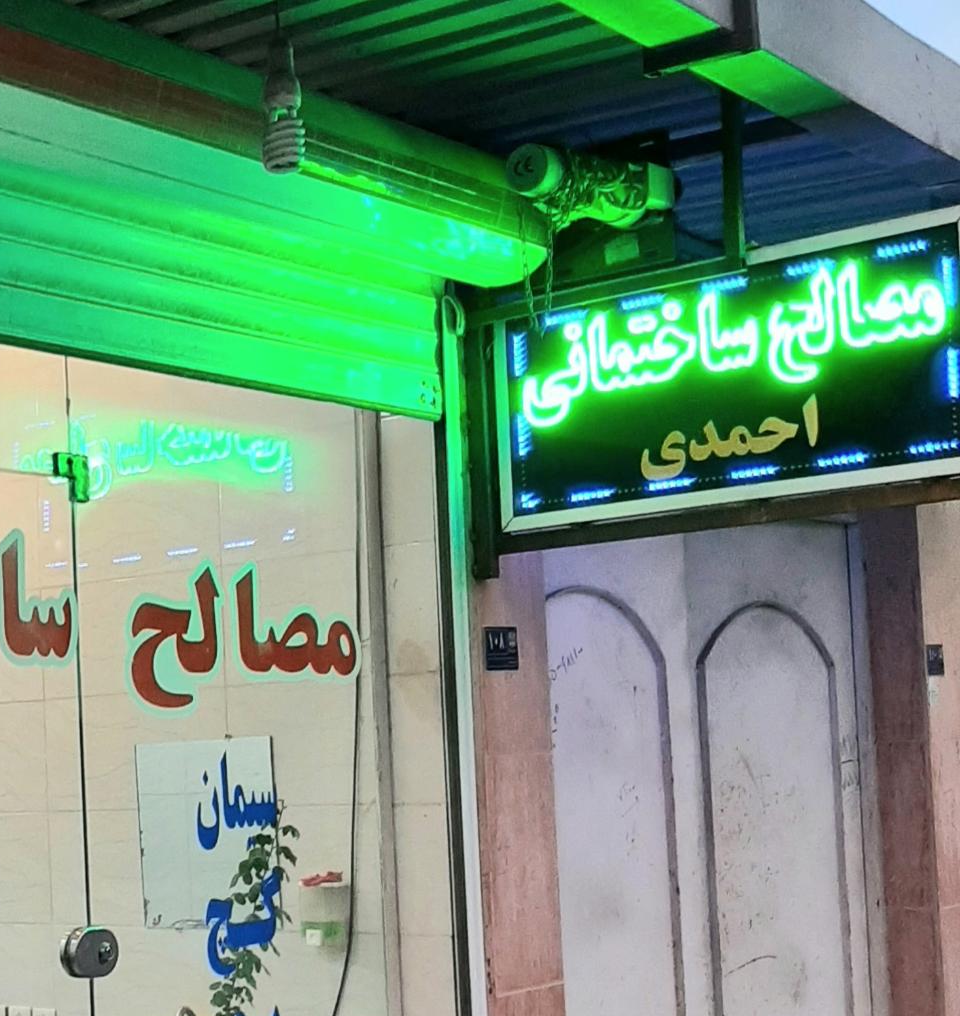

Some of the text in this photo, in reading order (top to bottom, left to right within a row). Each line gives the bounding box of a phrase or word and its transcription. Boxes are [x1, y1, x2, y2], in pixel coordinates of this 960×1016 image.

[521, 259, 946, 428] مصالح ساختمانی
[640, 394, 819, 480] احمدی
[125, 561, 359, 716] مصالح
[197, 750, 277, 850] سیمان
